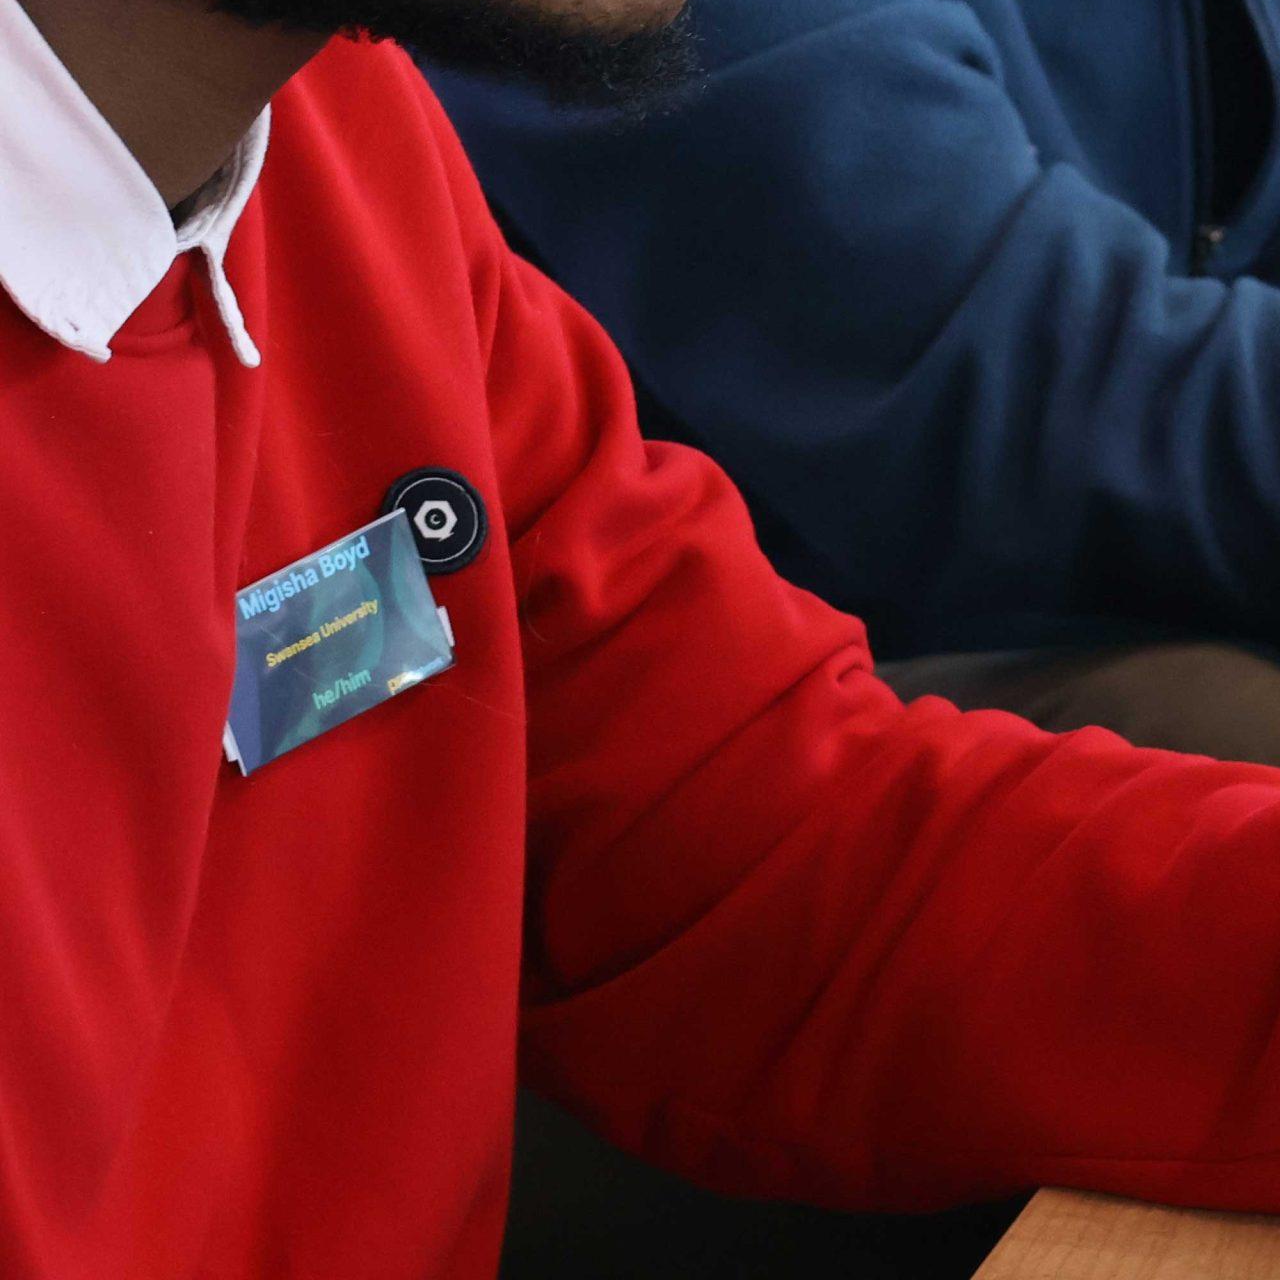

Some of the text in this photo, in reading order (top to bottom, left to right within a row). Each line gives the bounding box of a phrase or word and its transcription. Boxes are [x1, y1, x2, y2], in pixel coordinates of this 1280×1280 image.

[238, 535, 371, 620] Migisha Boyd
[265, 599, 378, 668] Swansea University
[311, 669, 372, 710] he/him
